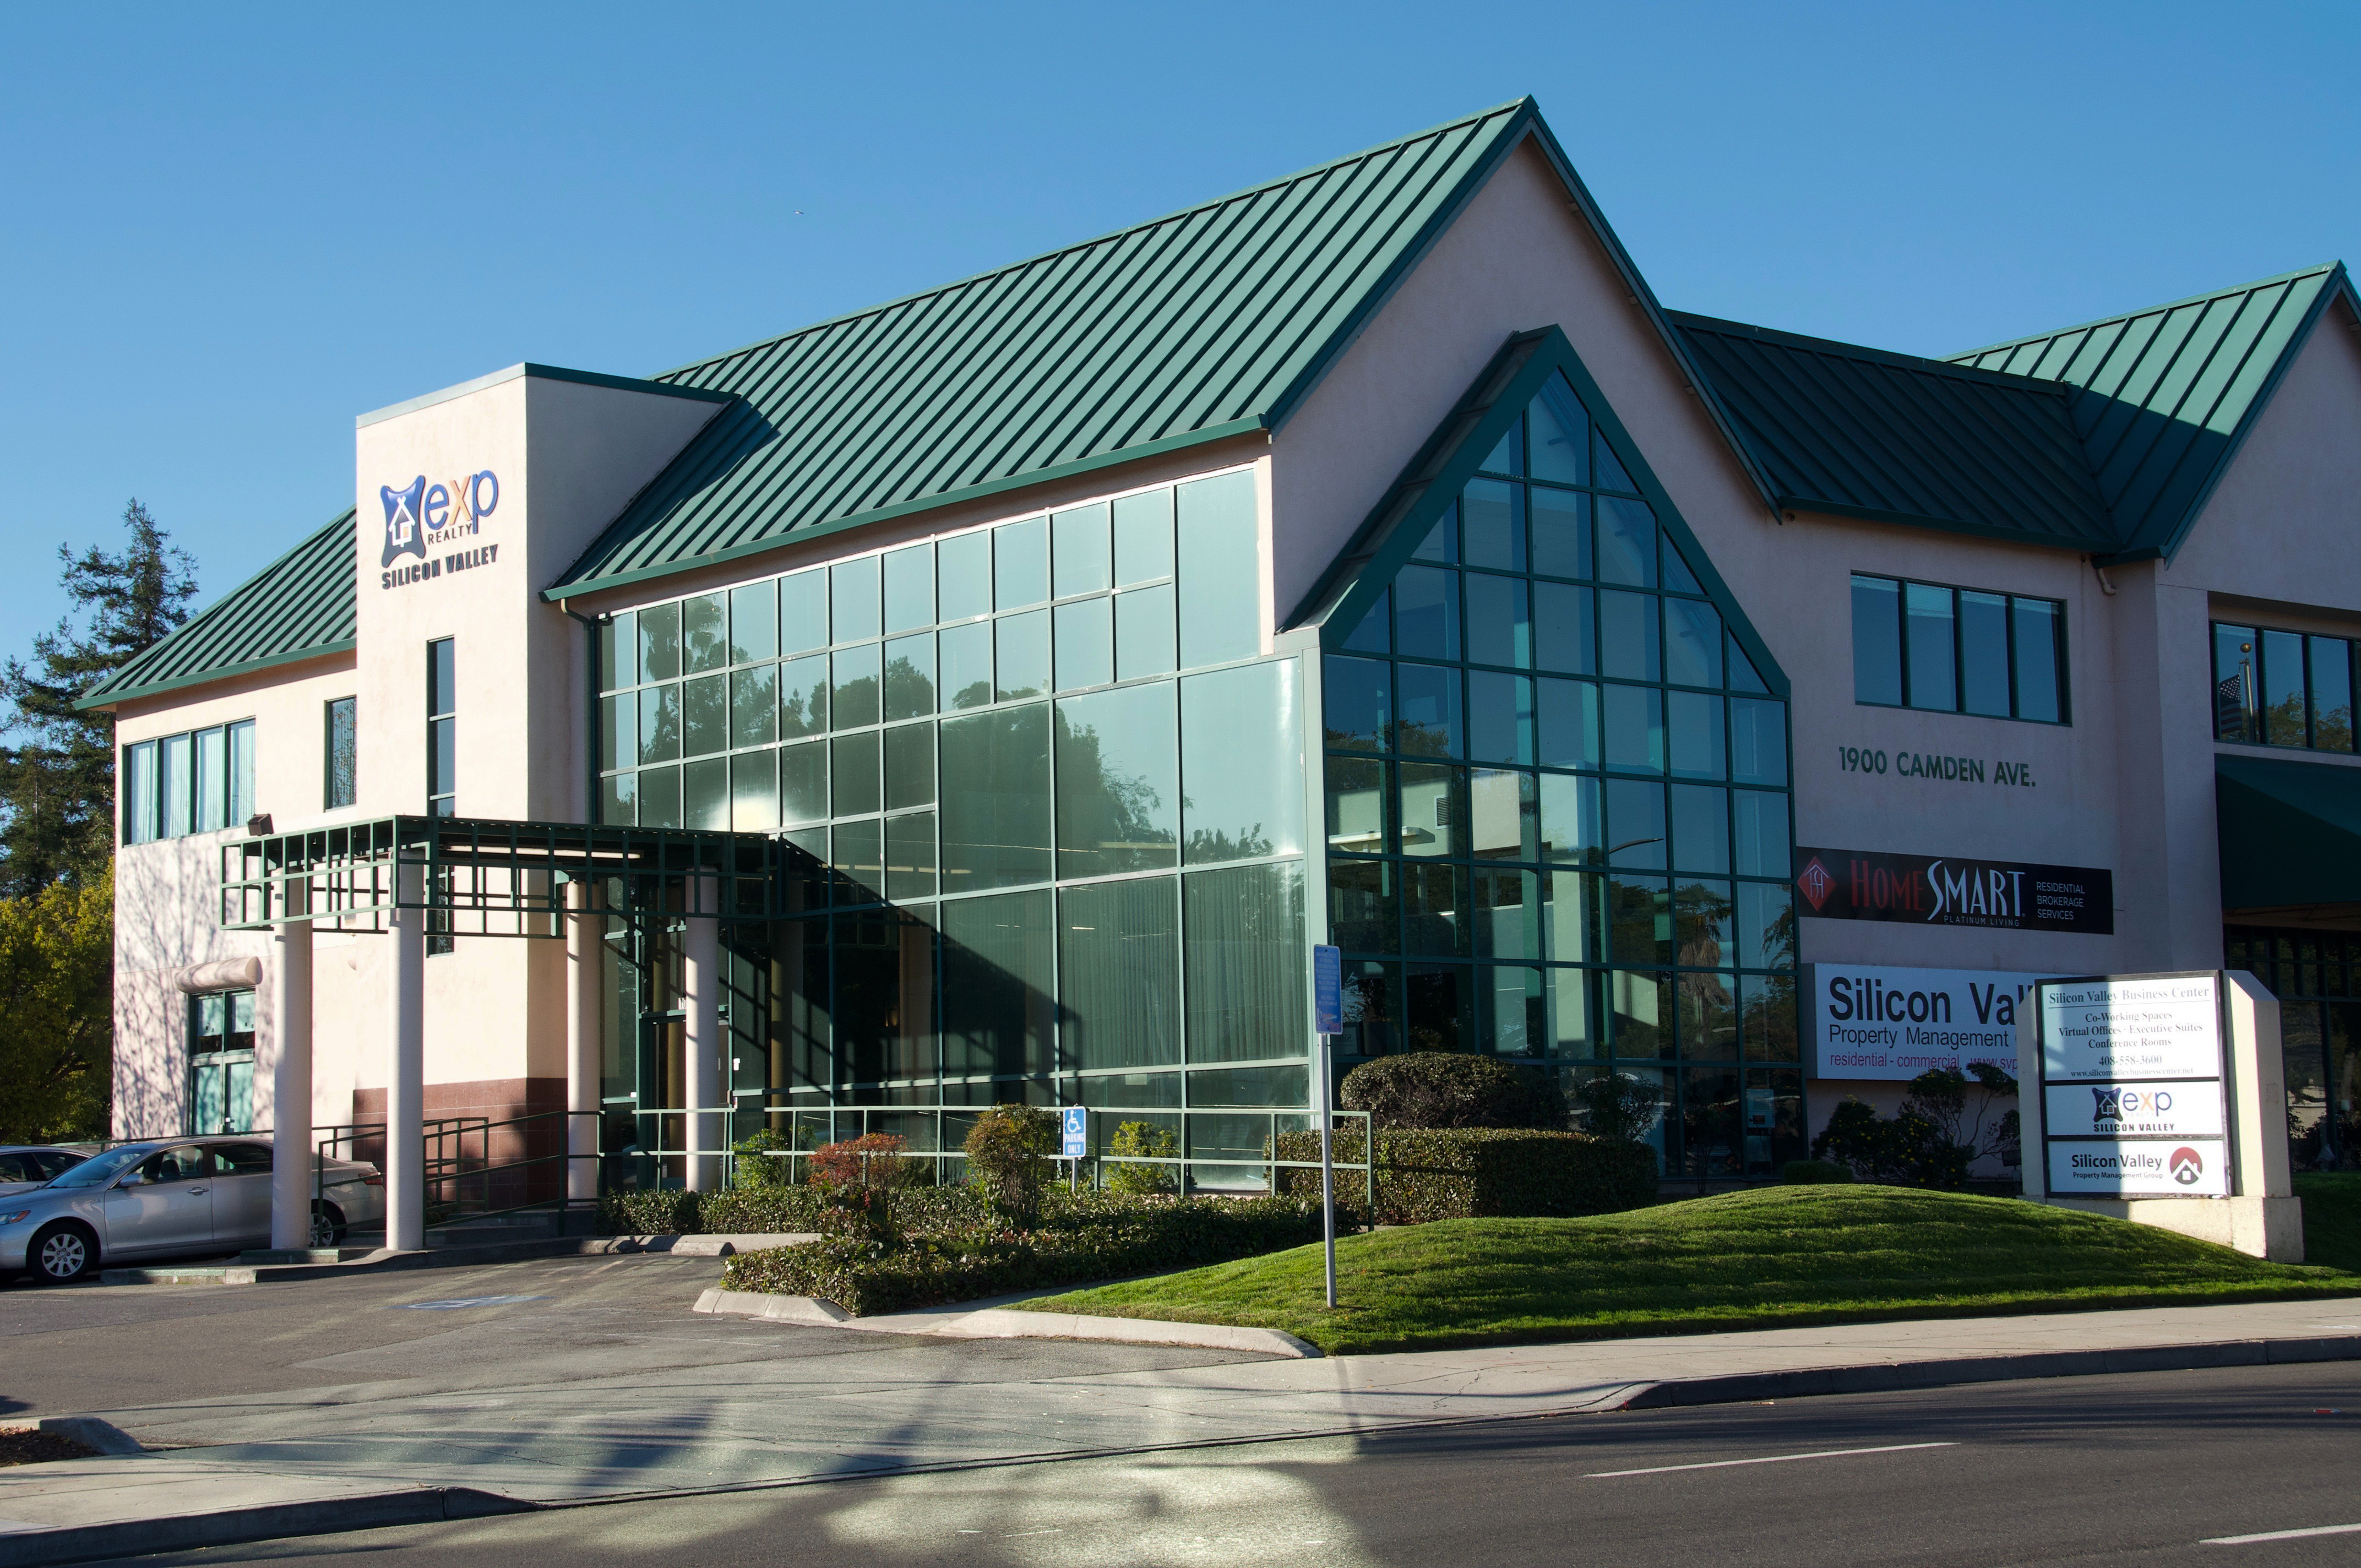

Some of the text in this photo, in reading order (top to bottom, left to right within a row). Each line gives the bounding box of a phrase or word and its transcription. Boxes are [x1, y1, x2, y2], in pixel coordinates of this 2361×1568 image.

[424, 470, 499, 535] exp
[427, 523, 474, 545] REALTY
[381, 543, 498, 590] SILICON VALLEY
[1838, 747, 2036, 787] 1900 CAMDEN AVE.
[2037, 881, 2085, 894] RESIDENTIAL
[2037, 895, 2083, 907] BROKERAGE
[1944, 915, 2020, 927] PLATINUM LIVING
[2037, 909, 2074, 920] SERVICES
[1829, 976, 1951, 1023] Silicon
[2049, 987, 2210, 1004] Silicon Valley Business Center
[2085, 1011, 2173, 1022] Co-Working Spaces
[2059, 1026, 2089, 1036] Virtual
[2092, 1025, 2121, 1035] Offices
[2129, 1023, 2173, 1033] Executive
[2175, 1023, 2203, 1032] Suites
[1830, 1024, 2009, 1050] Property Management
[2088, 1037, 2172, 1048] Conference Rooms
[1830, 1052, 1887, 1067] residential
[1897, 1054, 1960, 1068] commercial
[2098, 1055, 2162, 1066] 408-558-3600
[2123, 1092, 2172, 1117] exp
[2093, 1124, 2135, 1132] SILICON
[1064, 1133, 1084, 1142] PARKING
[1067, 1144, 1081, 1154] ONLY
[2071, 1153, 2162, 1170] Silicon Valley
[2073, 1172, 2100, 1180] Property
